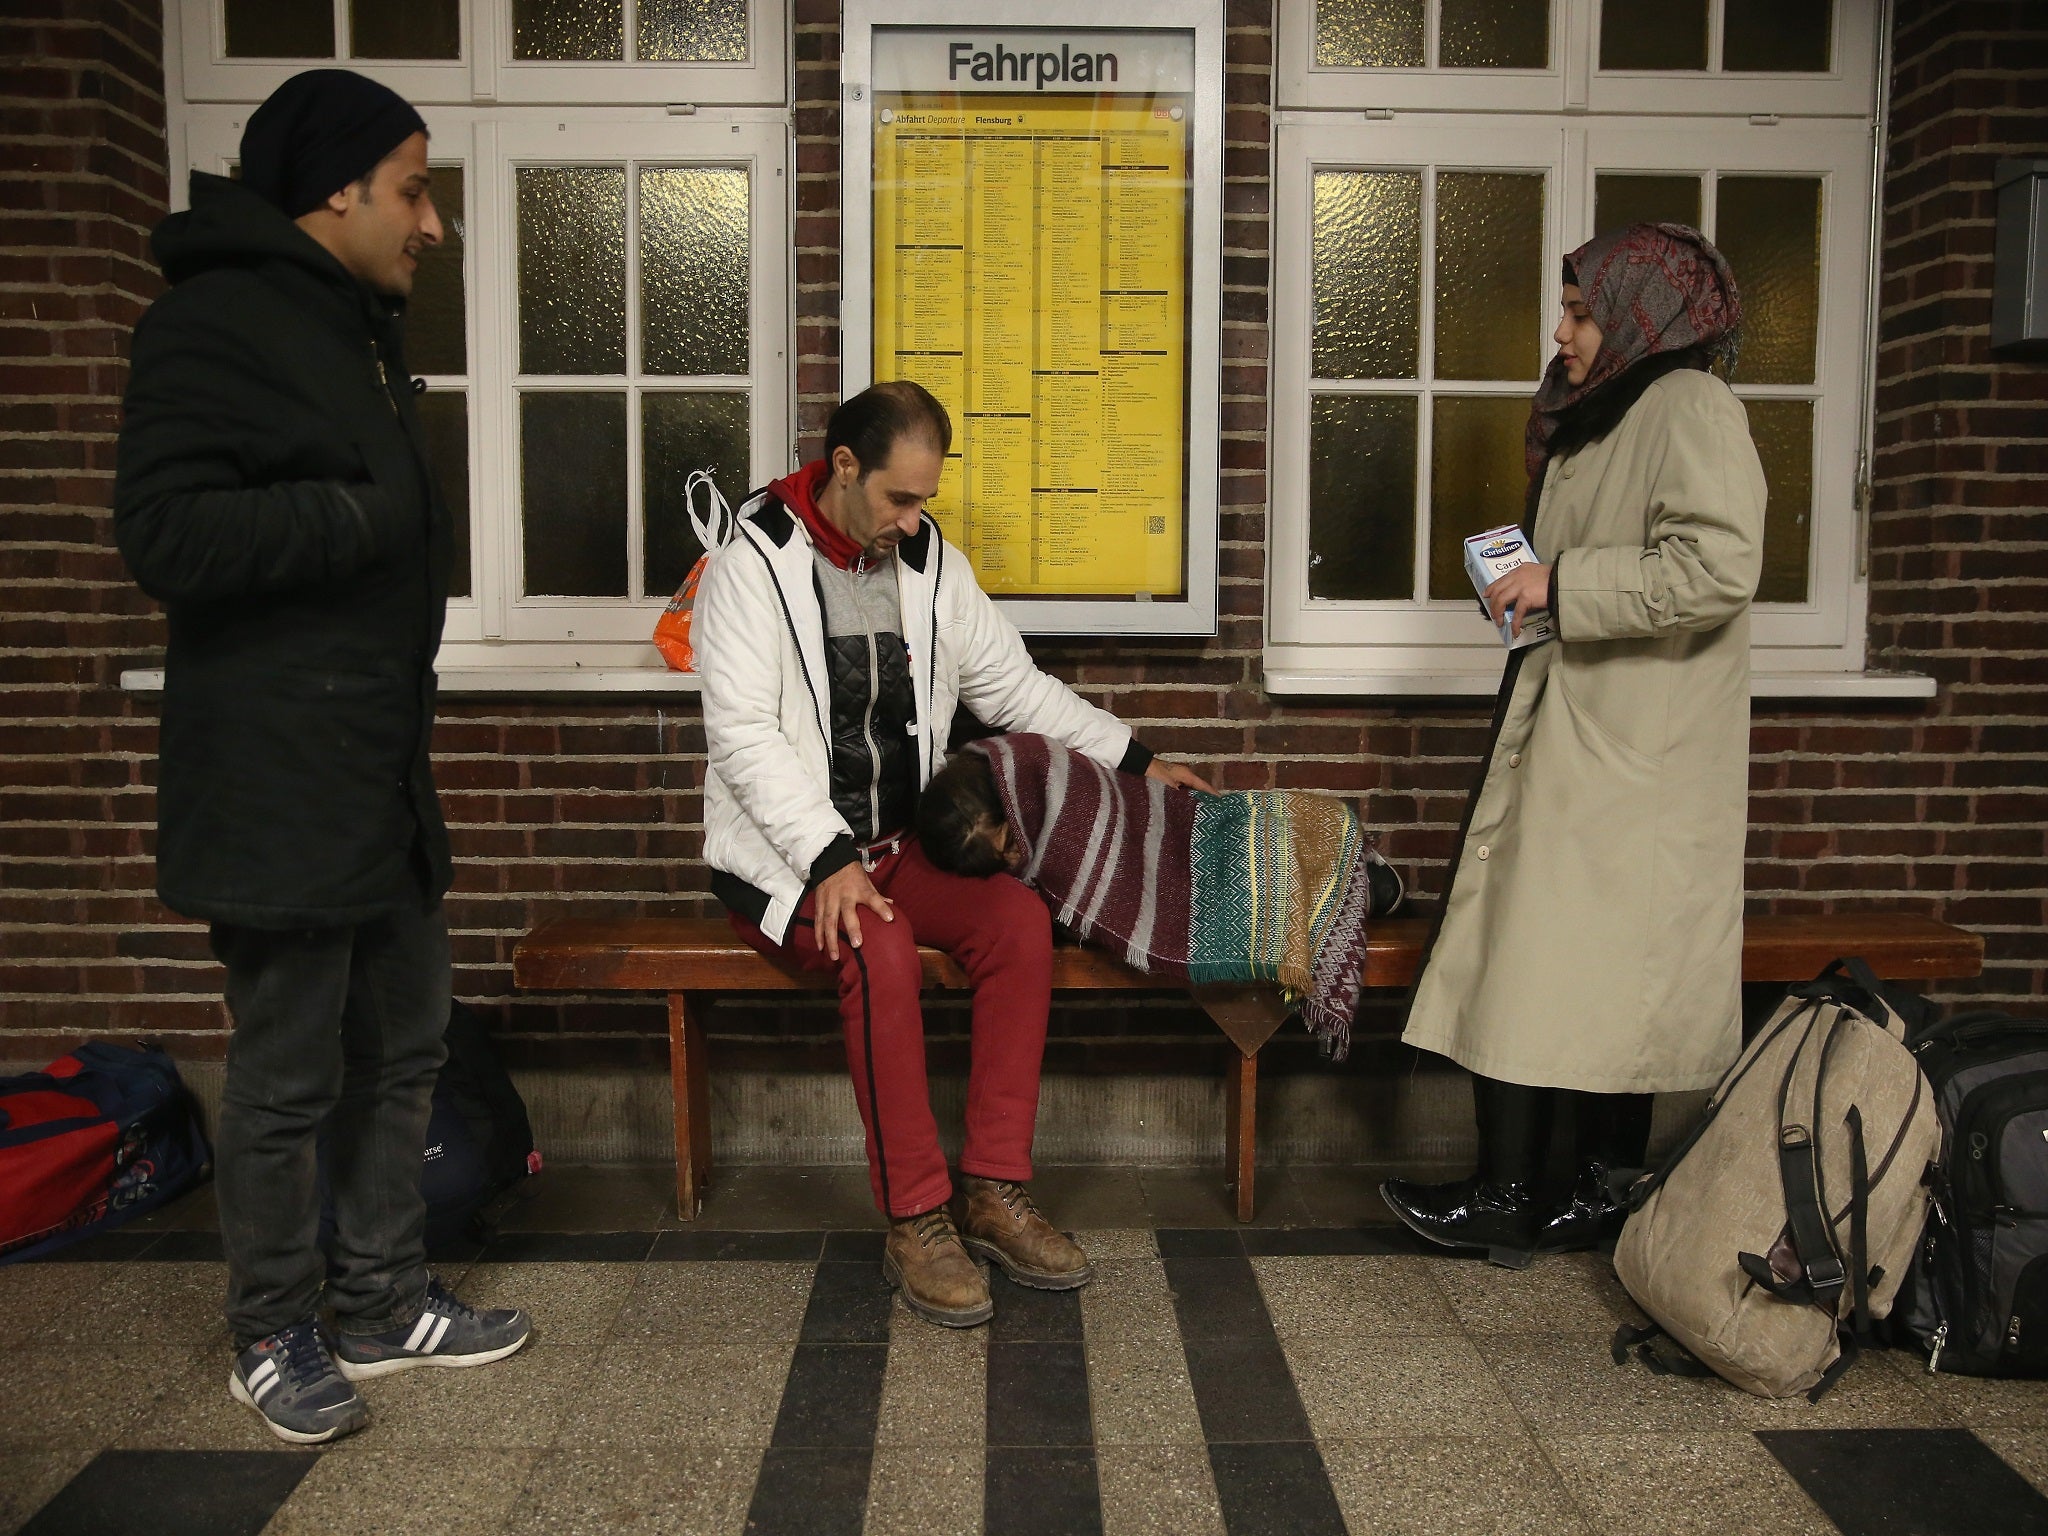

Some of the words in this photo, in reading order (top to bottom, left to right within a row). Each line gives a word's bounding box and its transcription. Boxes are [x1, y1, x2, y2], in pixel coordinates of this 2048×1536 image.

[949, 43, 1118, 90] Fahrplan
[896, 115, 926, 124] Abfahrt
[927, 115, 966, 125] Departure
[975, 116, 1012, 125] Flensburg
[1482, 542, 1520, 557] Christinen
[1495, 558, 1522, 571] Carat
